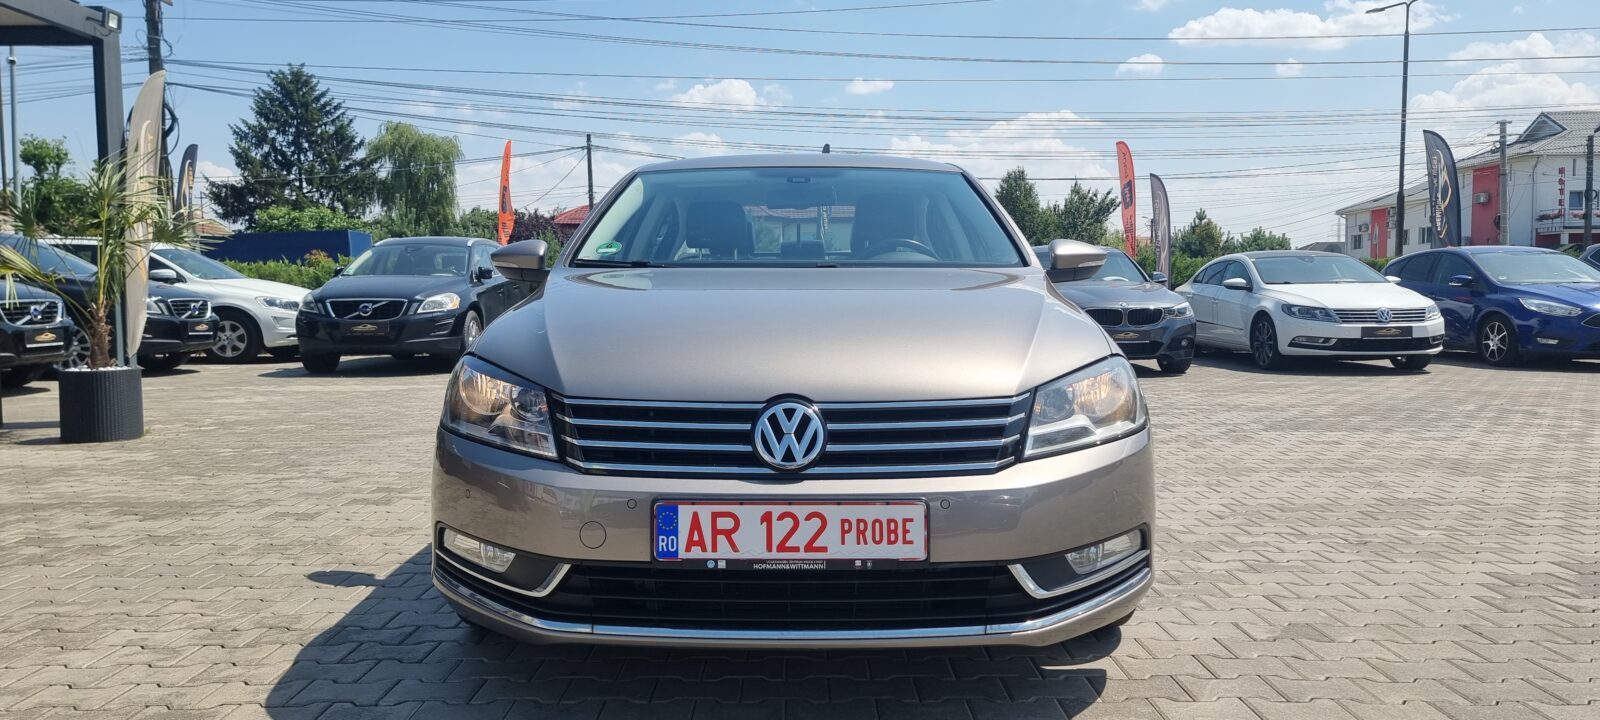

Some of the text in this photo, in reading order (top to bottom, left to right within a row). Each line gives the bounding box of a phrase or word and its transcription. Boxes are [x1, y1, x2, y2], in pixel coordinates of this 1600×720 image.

[755, 403, 823, 469] VW
[658, 536, 677, 552] RO
[684, 511, 914, 553] AR 122 PROBE
